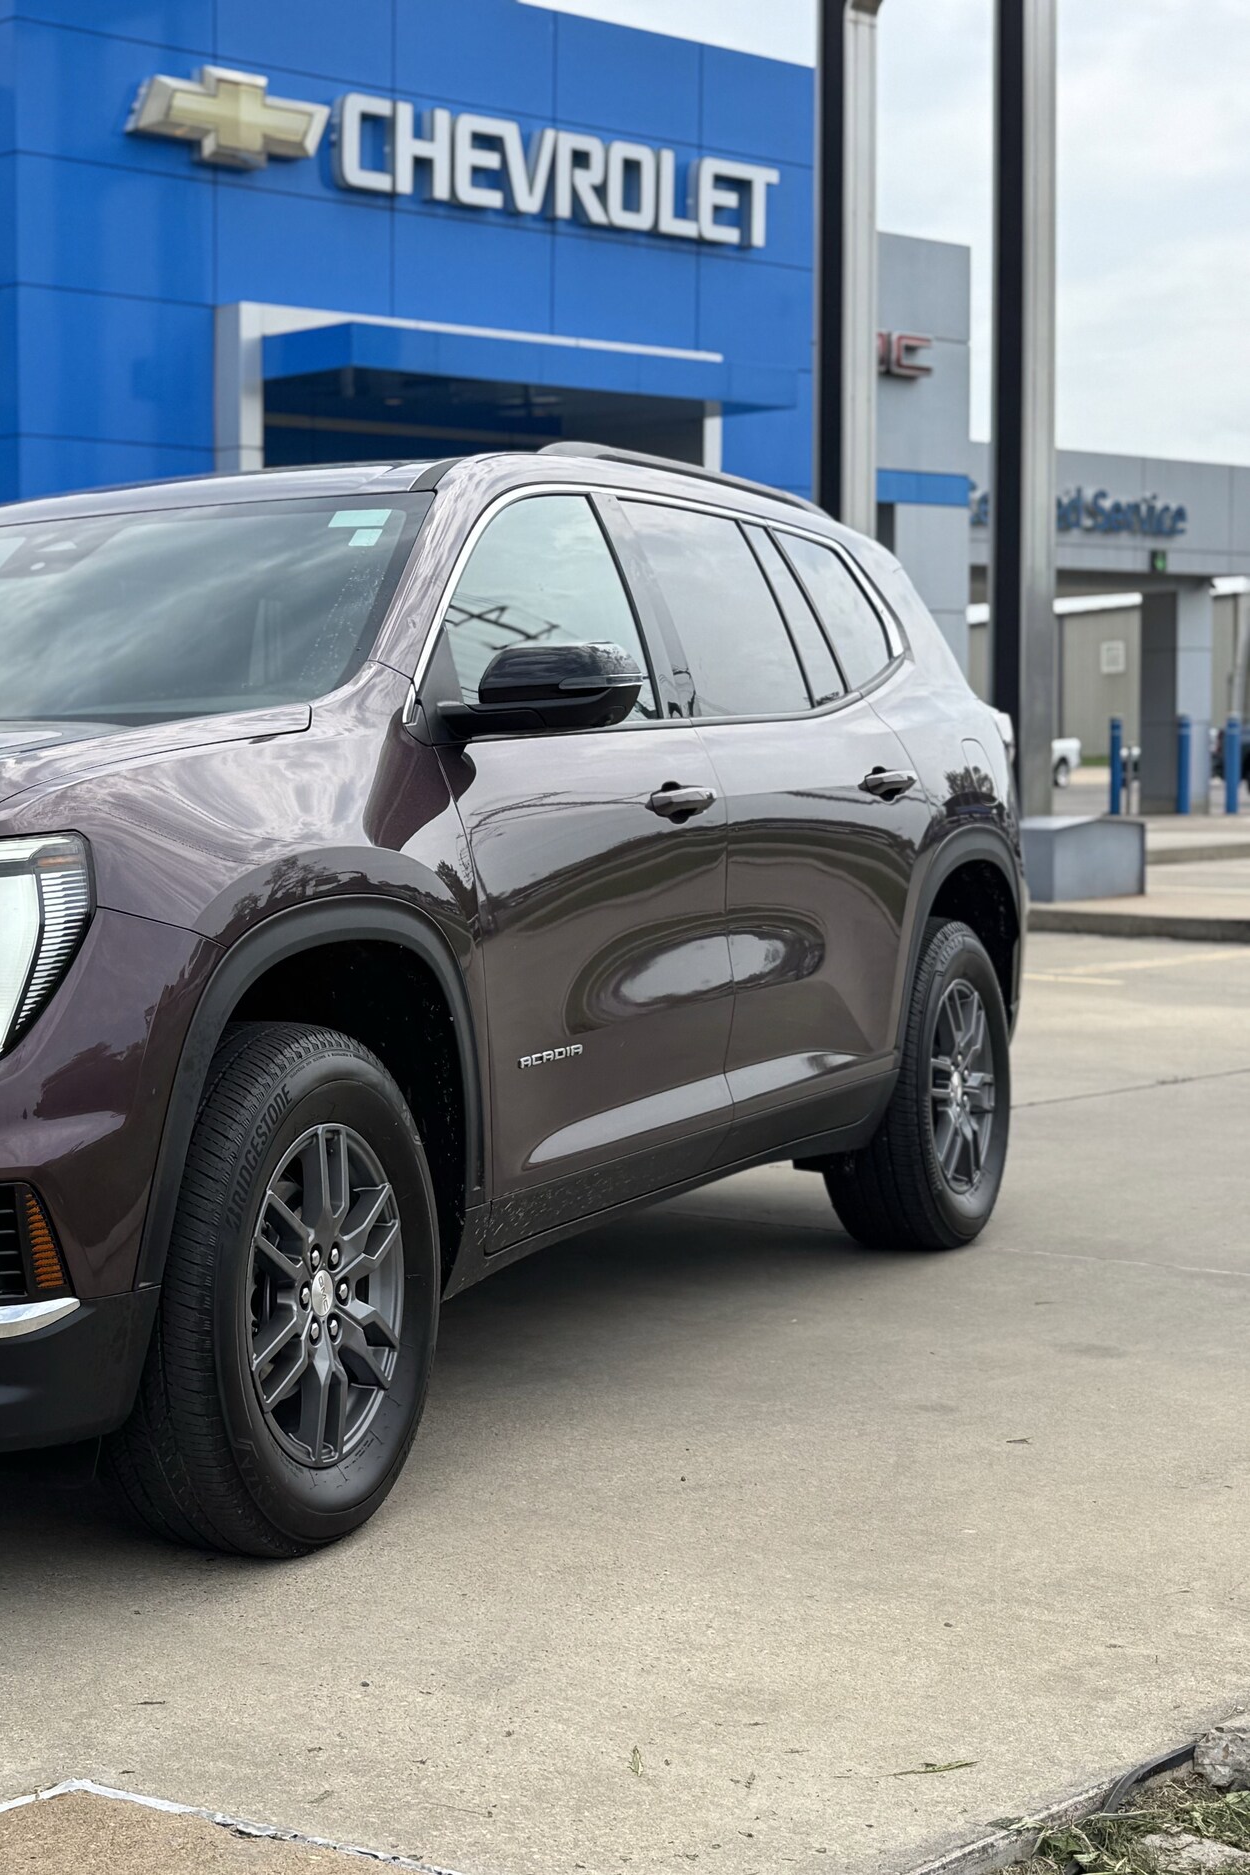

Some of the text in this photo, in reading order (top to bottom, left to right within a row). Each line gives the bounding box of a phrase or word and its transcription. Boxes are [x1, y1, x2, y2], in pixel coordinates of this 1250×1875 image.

[336, 92, 780, 247] CHEVROLET
[1092, 488, 1187, 536] Service
[518, 1043, 583, 1069] ACADIA
[226, 1083, 293, 1231] BRIDGESTONE
[318, 1275, 329, 1312] GMC
